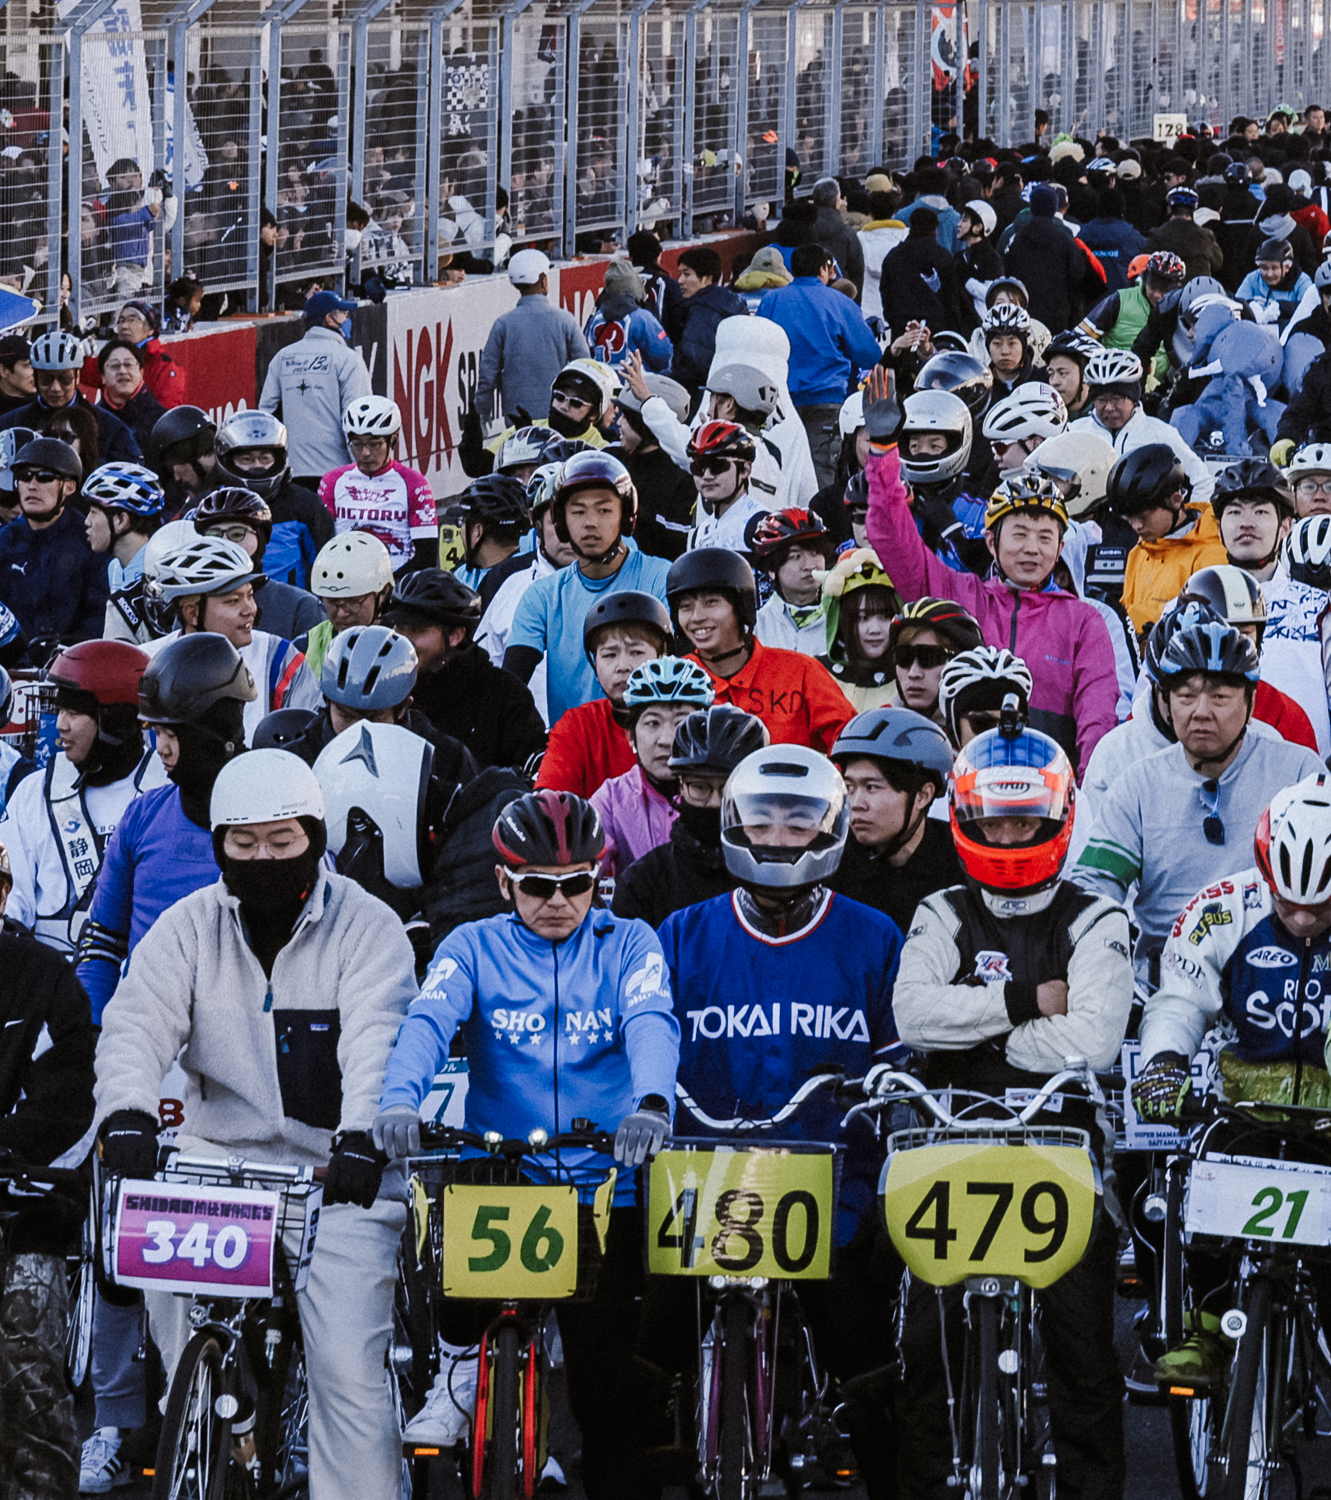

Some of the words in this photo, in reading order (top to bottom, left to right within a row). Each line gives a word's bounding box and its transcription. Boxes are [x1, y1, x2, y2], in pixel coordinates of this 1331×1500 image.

[393, 315, 454, 474] NGK
[1250, 948, 1296, 966] AREO
[491, 1008, 545, 1031] SHO
[565, 1008, 612, 1031] NAN
[687, 1003, 781, 1042] TOKAI
[791, 1002, 870, 1042] RIKA
[656, 1188, 820, 1273] 480
[904, 1180, 1070, 1263] 479
[1241, 1186, 1310, 1238] 21
[142, 1220, 248, 1269] 340
[467, 1205, 565, 1273] 56
